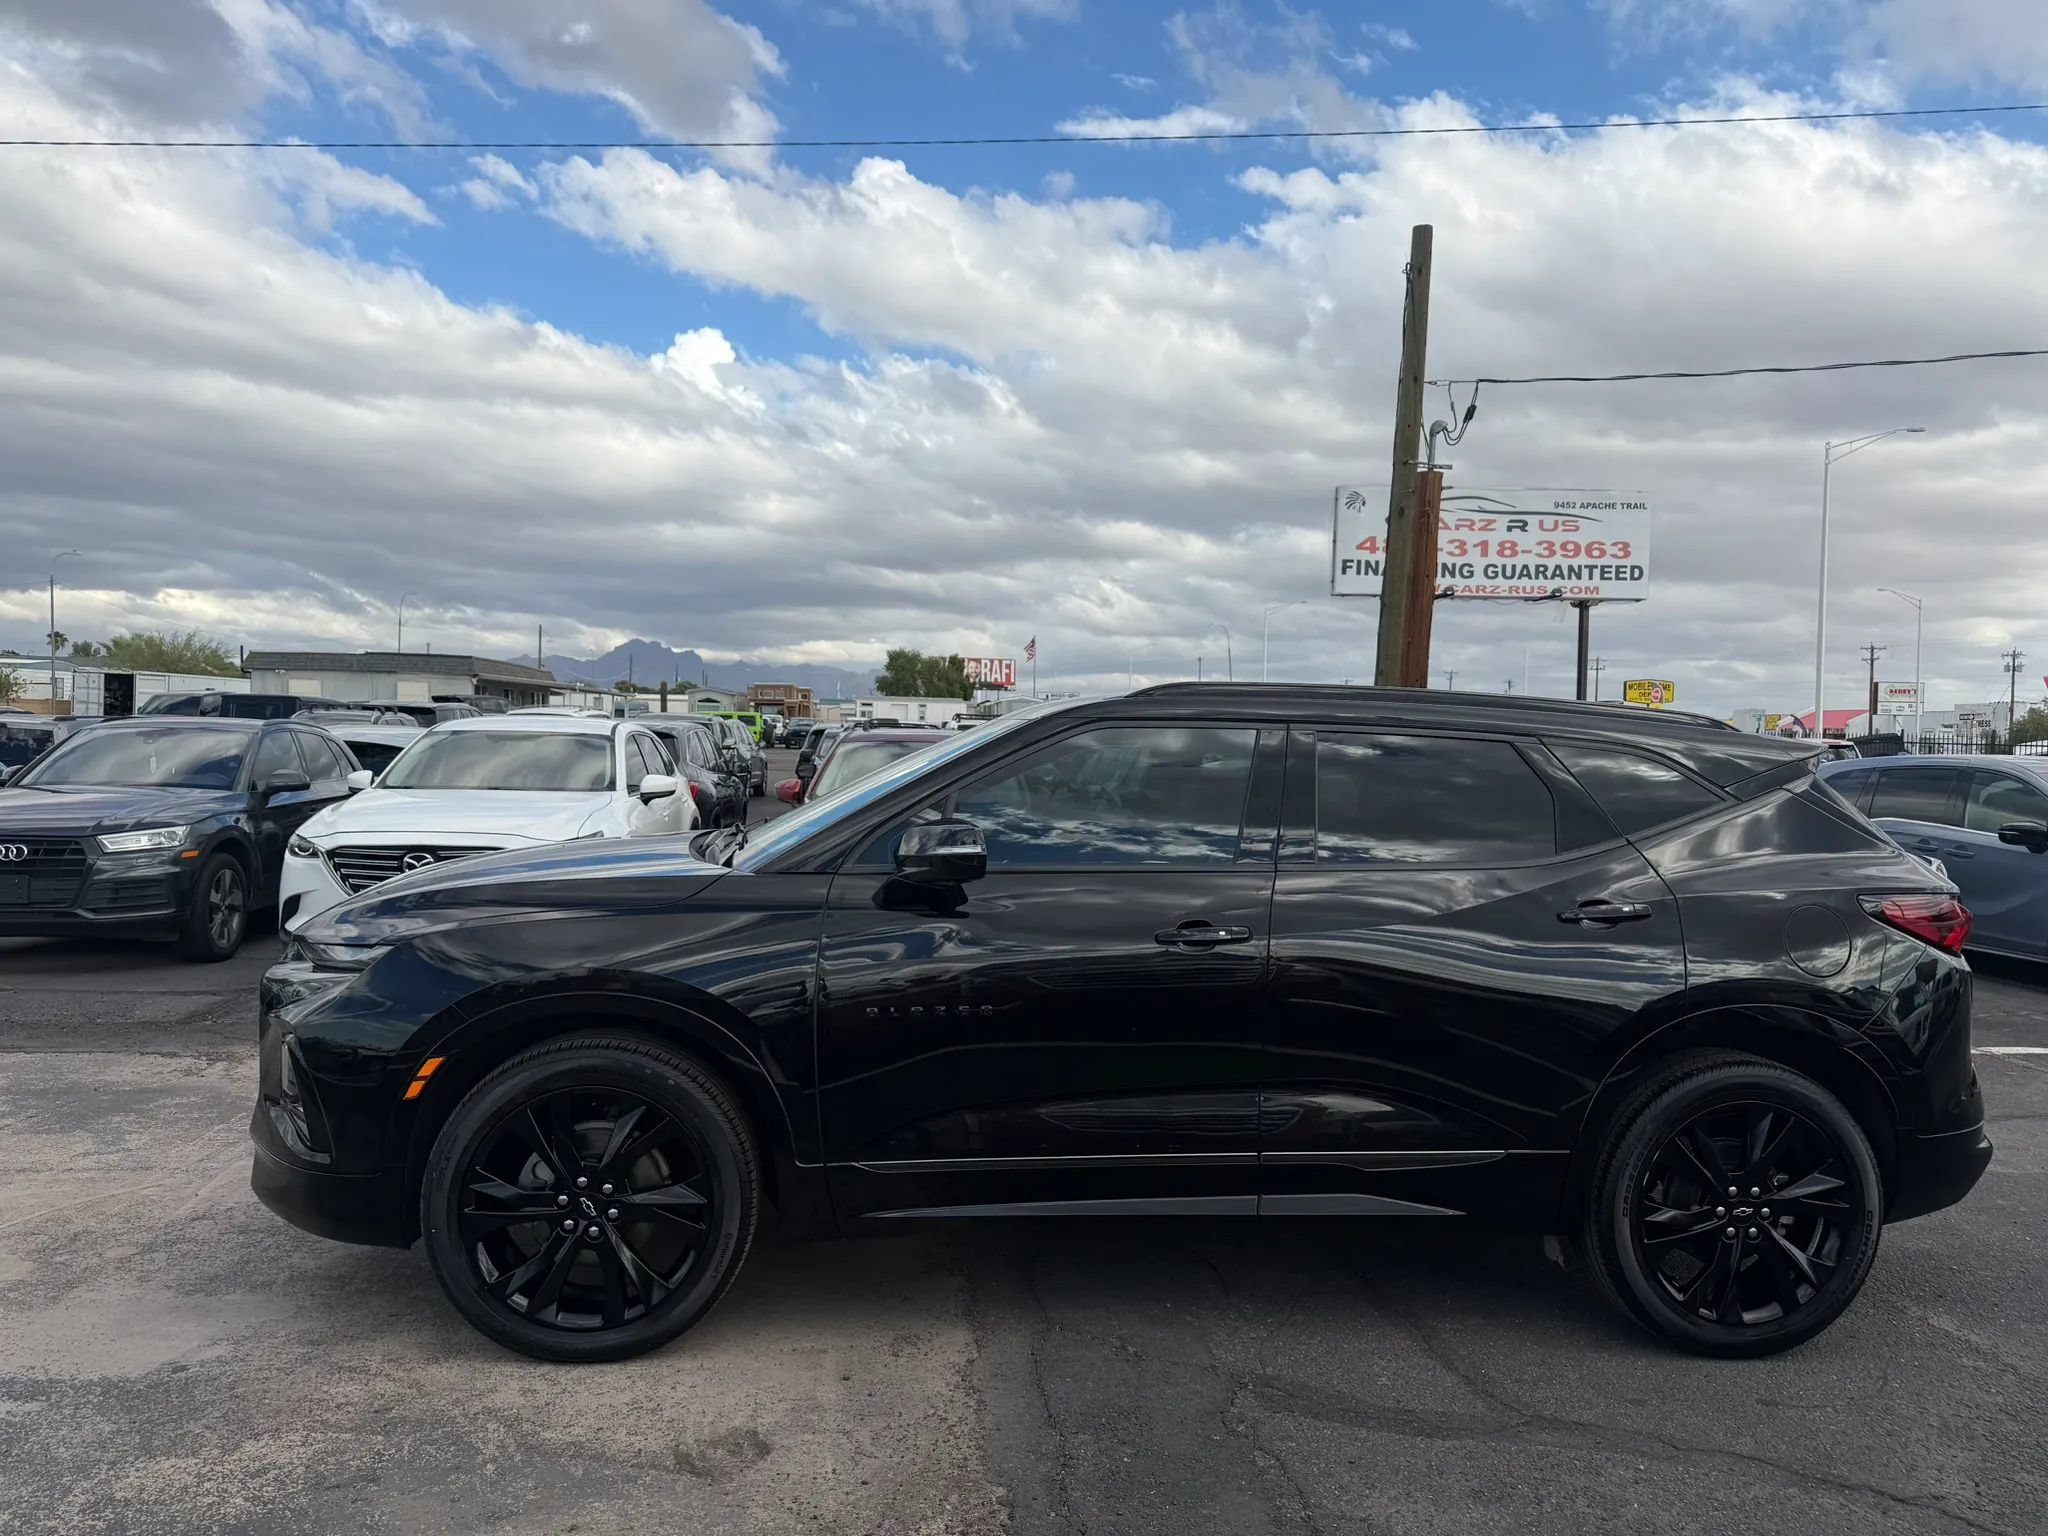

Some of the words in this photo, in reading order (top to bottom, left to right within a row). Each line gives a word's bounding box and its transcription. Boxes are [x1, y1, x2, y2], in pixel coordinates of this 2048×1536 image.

[1553, 501, 1577, 510] 9452
[1579, 501, 1618, 510] APACHE
[1620, 502, 1648, 510] TRAIL
[1437, 517, 1497, 532] ARZ
[1506, 519, 1529, 533] R
[1538, 519, 1581, 533] US
[1355, 536, 1632, 560] 4-318-3963
[1341, 558, 1475, 580] FINNG
[1483, 563, 1644, 582] GUARANTEED
[980, 659, 1015, 683] RAFI
[1628, 681, 1652, 691] MOBILE
[866, 1004, 993, 1017] BLAZER
